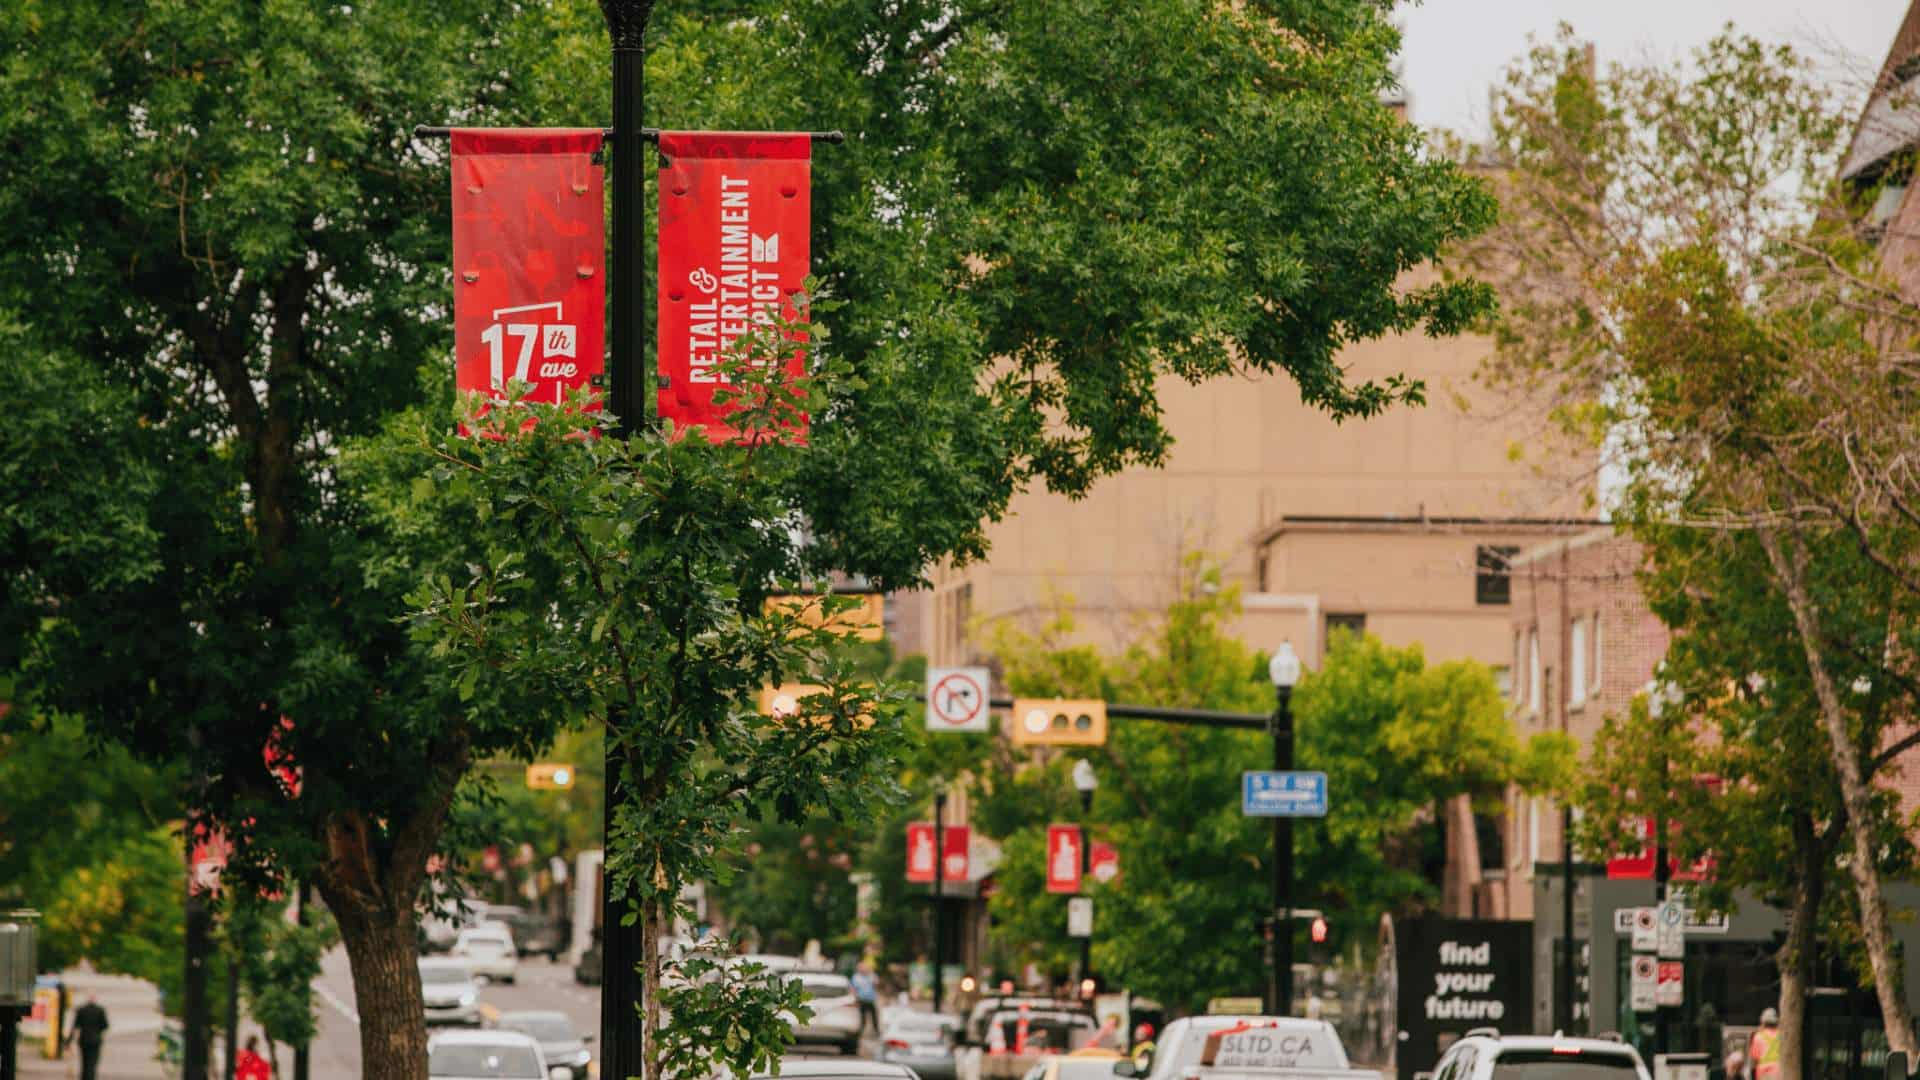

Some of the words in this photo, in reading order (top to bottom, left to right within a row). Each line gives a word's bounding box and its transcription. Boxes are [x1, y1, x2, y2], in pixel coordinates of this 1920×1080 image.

[689, 267, 718, 294] &
[689, 298, 717, 383] RETAIL
[540, 362, 577, 378] ave
[1439, 941, 1490, 965] find
[1435, 973, 1495, 995] your
[1425, 995, 1504, 1019] future
